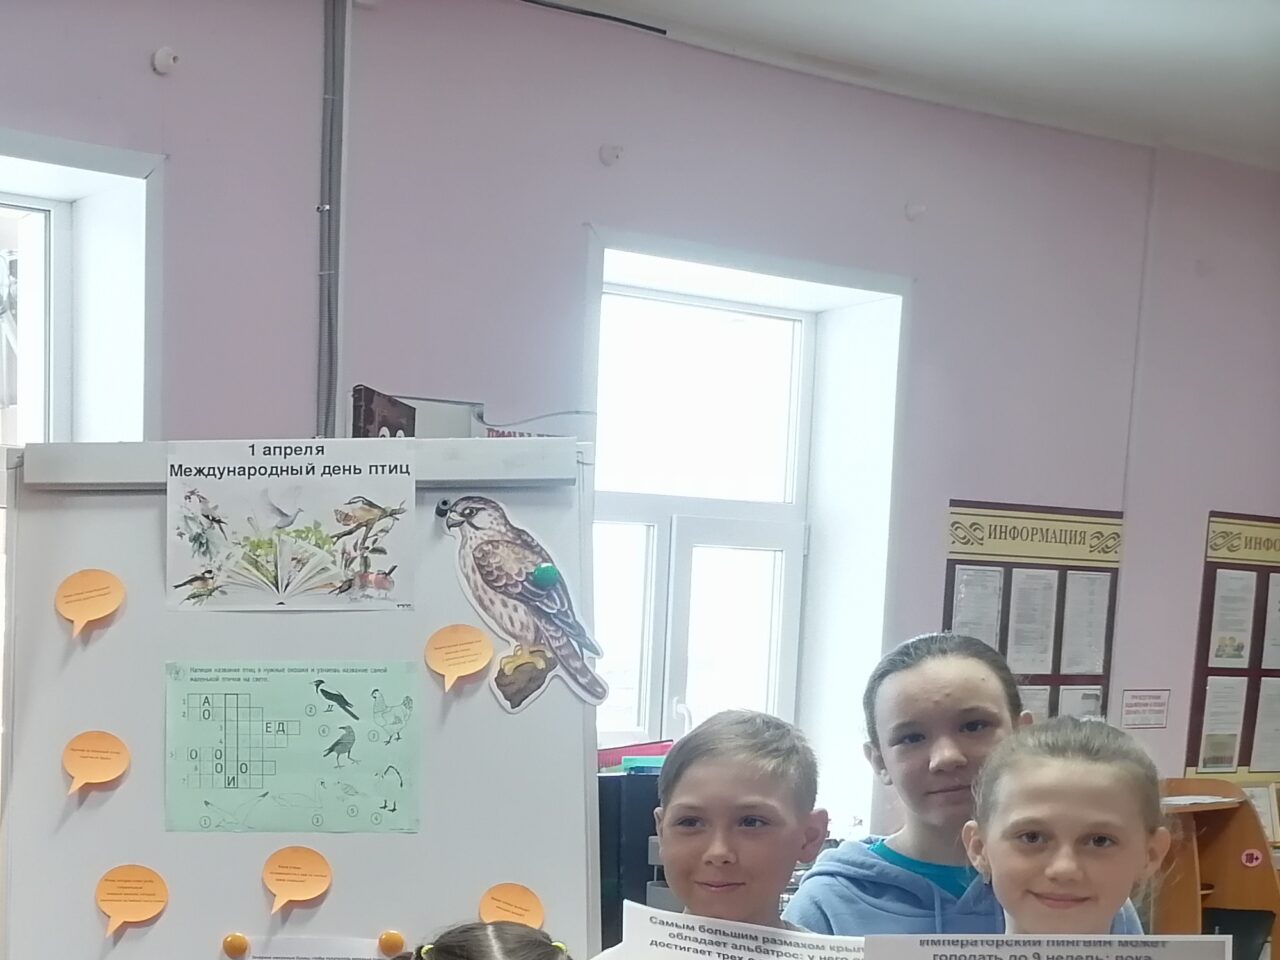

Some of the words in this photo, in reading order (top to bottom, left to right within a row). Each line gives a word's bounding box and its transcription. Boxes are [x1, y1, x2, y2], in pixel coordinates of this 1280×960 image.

[248, 444, 256, 456] 1
[262, 445, 325, 459] апреля
[169, 463, 316, 480] Международный
[320, 464, 362, 478] день
[368, 463, 411, 476] птиц
[987, 523, 1088, 546] ИНФОРМАЦИЯ
[202, 696, 211, 706] А
[227, 776, 236, 787] И
[648, 915, 696, 932] Самым
[698, 924, 759, 942] большим
[761, 935, 826, 952] размахом
[648, 937, 713, 957] достигает
[668, 931, 728, 949] обладает
[730, 940, 805, 960] альбатрос:
